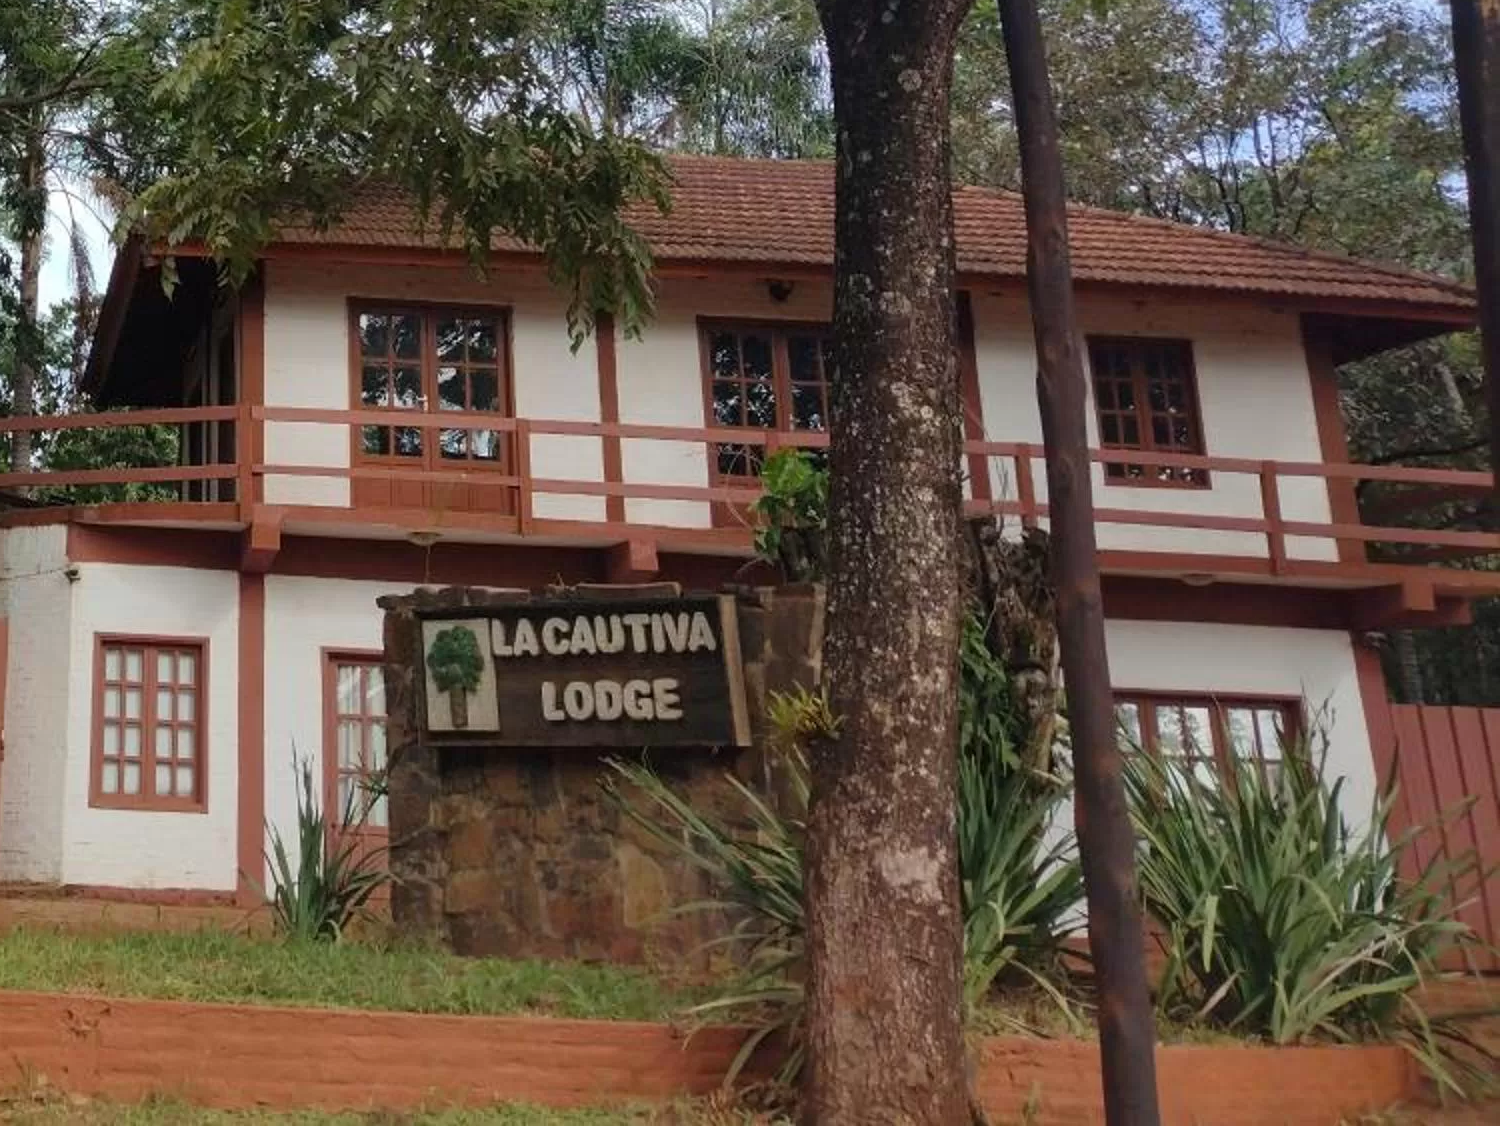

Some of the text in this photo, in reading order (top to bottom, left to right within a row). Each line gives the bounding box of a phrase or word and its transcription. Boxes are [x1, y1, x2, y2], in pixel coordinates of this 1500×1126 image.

[492, 611, 717, 657] LA CAUTIVA
[541, 678, 683, 722] LODGE
